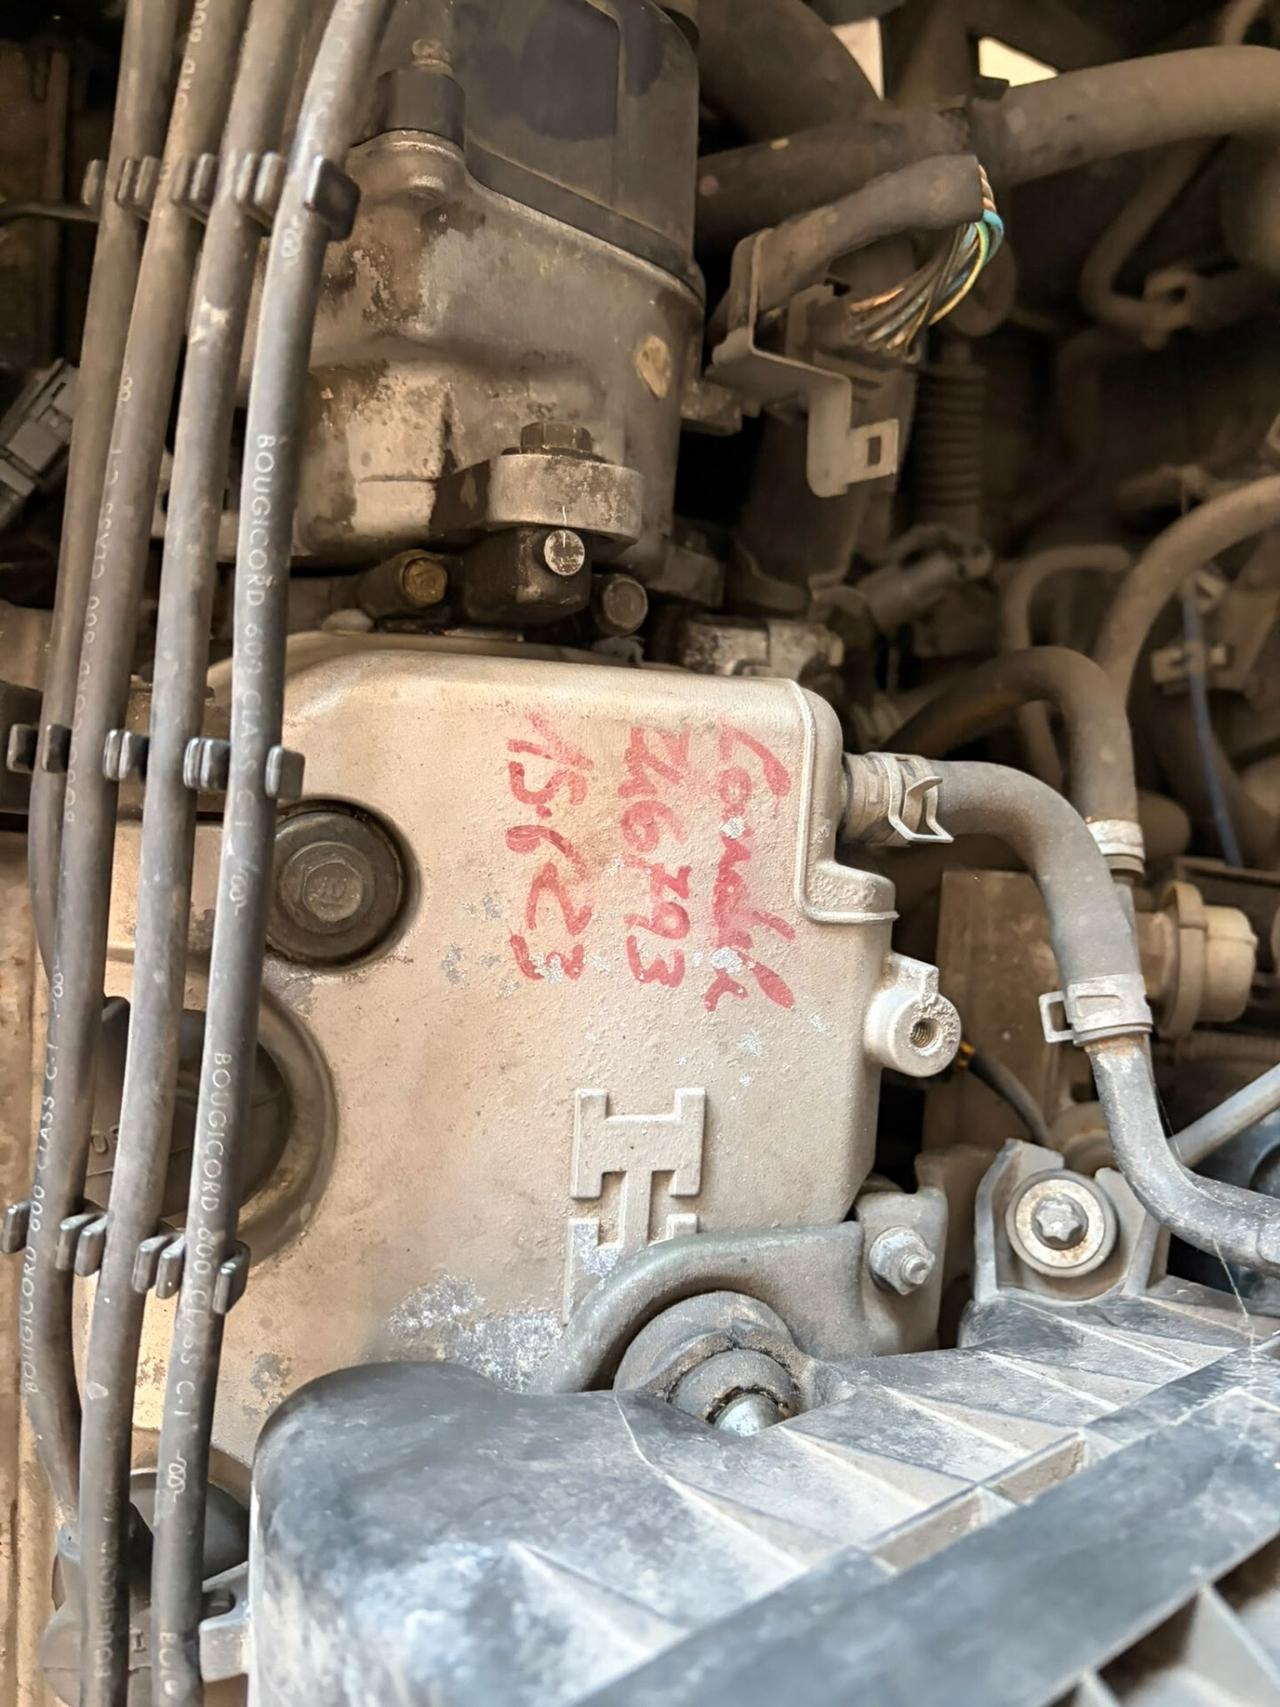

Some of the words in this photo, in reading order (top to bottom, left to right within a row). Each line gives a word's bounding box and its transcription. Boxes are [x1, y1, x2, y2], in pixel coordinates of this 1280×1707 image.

[243, 433, 278, 607] BOUGICORD
[236, 689, 264, 773] CLASS
[199, 1050, 233, 1212] BOUGICORD
[20, 1244, 40, 1394] BOUGICORD
